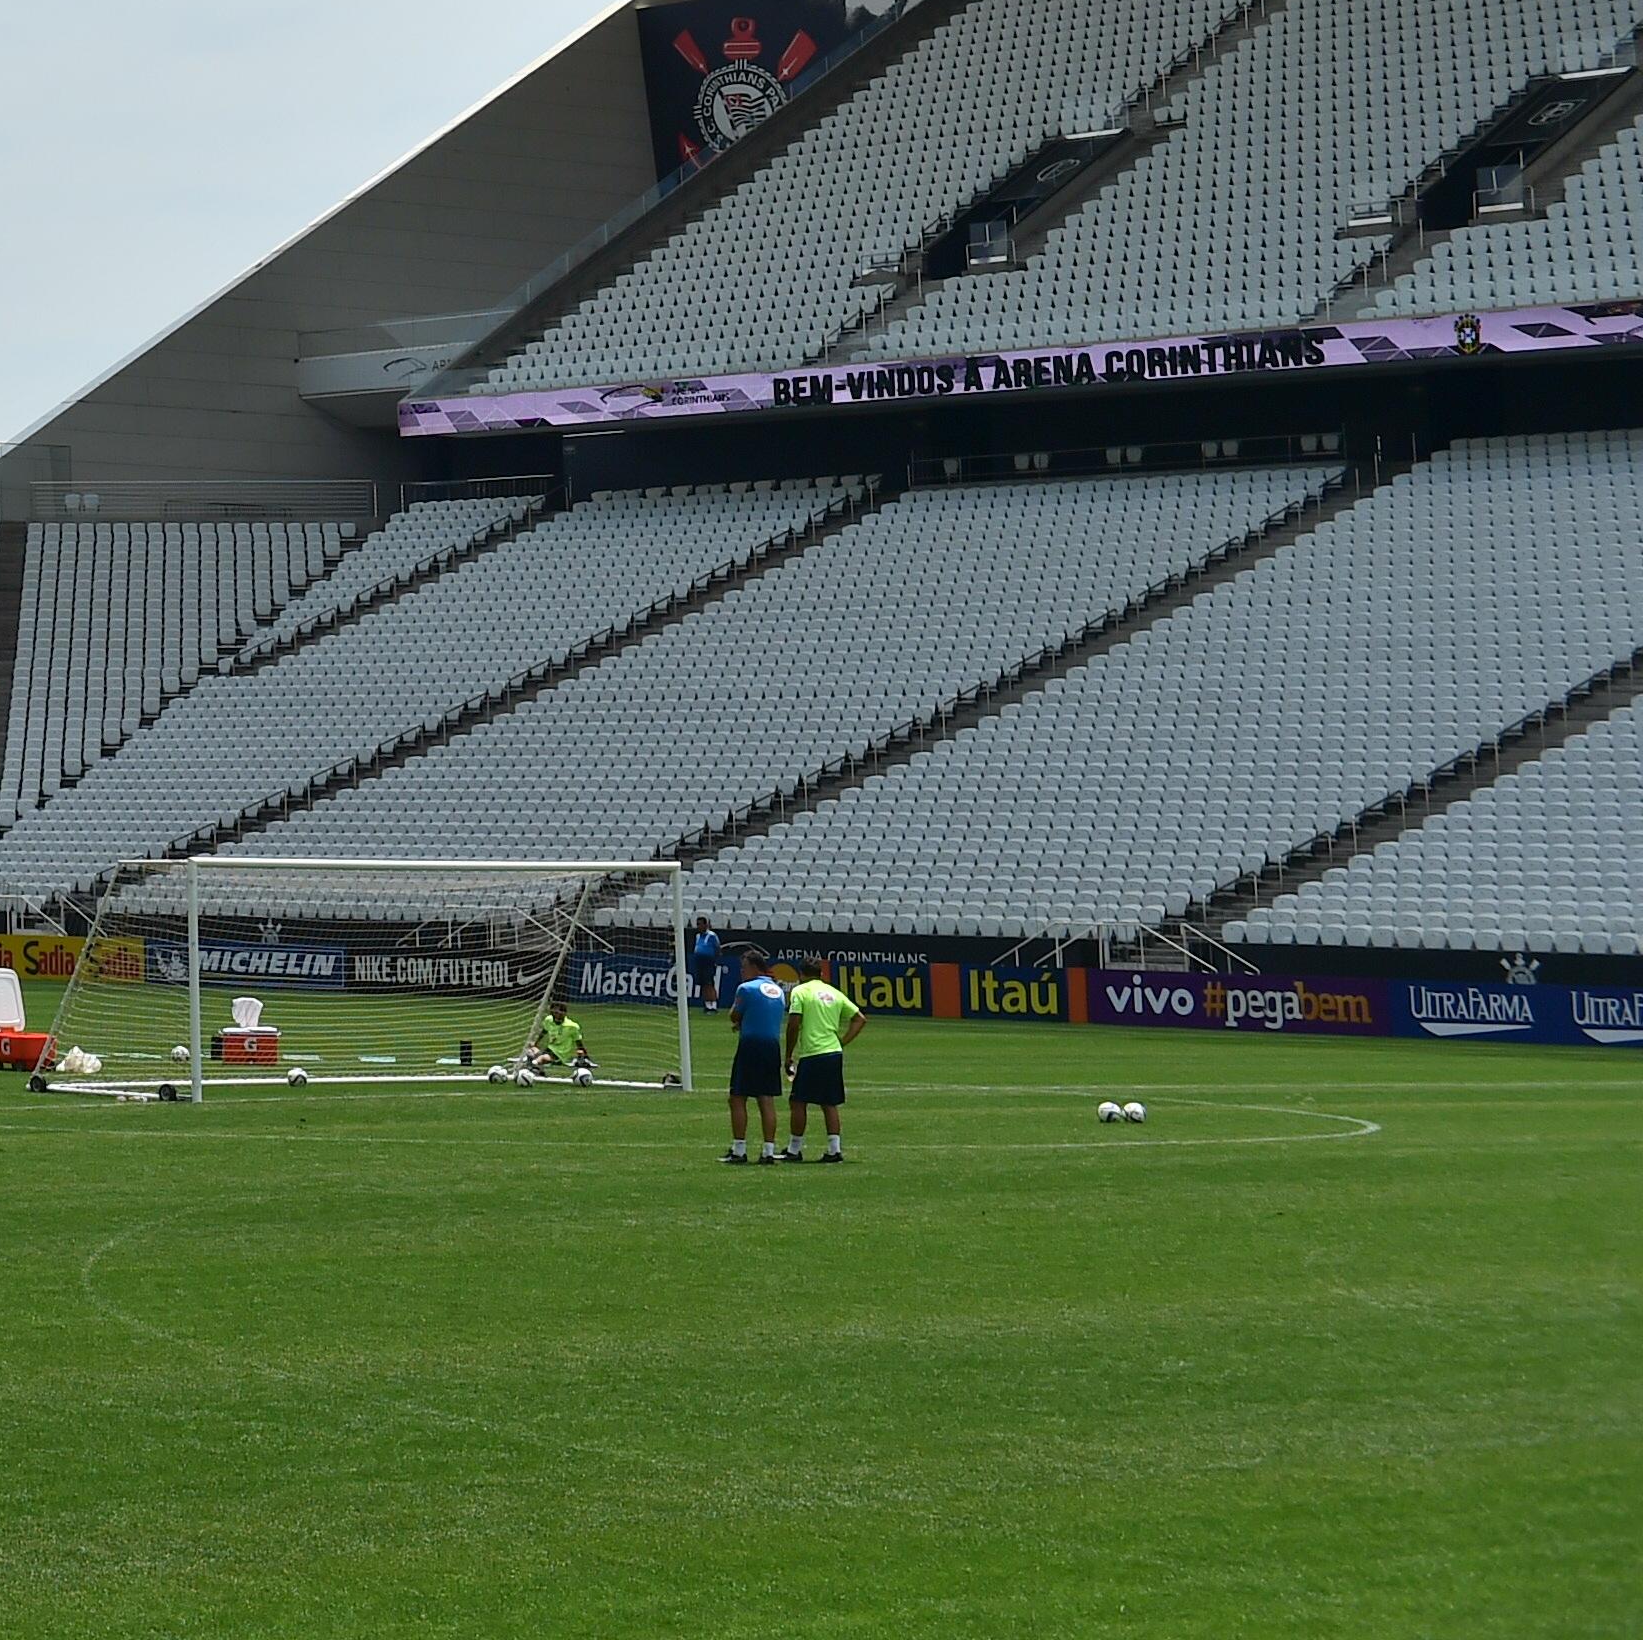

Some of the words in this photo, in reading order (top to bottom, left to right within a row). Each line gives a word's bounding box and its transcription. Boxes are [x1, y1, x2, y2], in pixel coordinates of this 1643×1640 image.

[703, 71, 765, 117] CORINTHIANS
[773, 365, 955, 406] BEM-VINDOS
[993, 351, 1096, 389] ARENA
[1104, 335, 1325, 381] CORINTHIANS
[23, 940, 75, 976] Sadia
[198, 950, 337, 976] MICHELIN
[354, 955, 514, 990] NIKE.COM/FUTEBOL
[838, 965, 923, 1009] Itaú
[969, 968, 1059, 1015] Itaú
[1106, 974, 1195, 1017] vivo
[1203, 980, 1373, 1030] #pegabem
